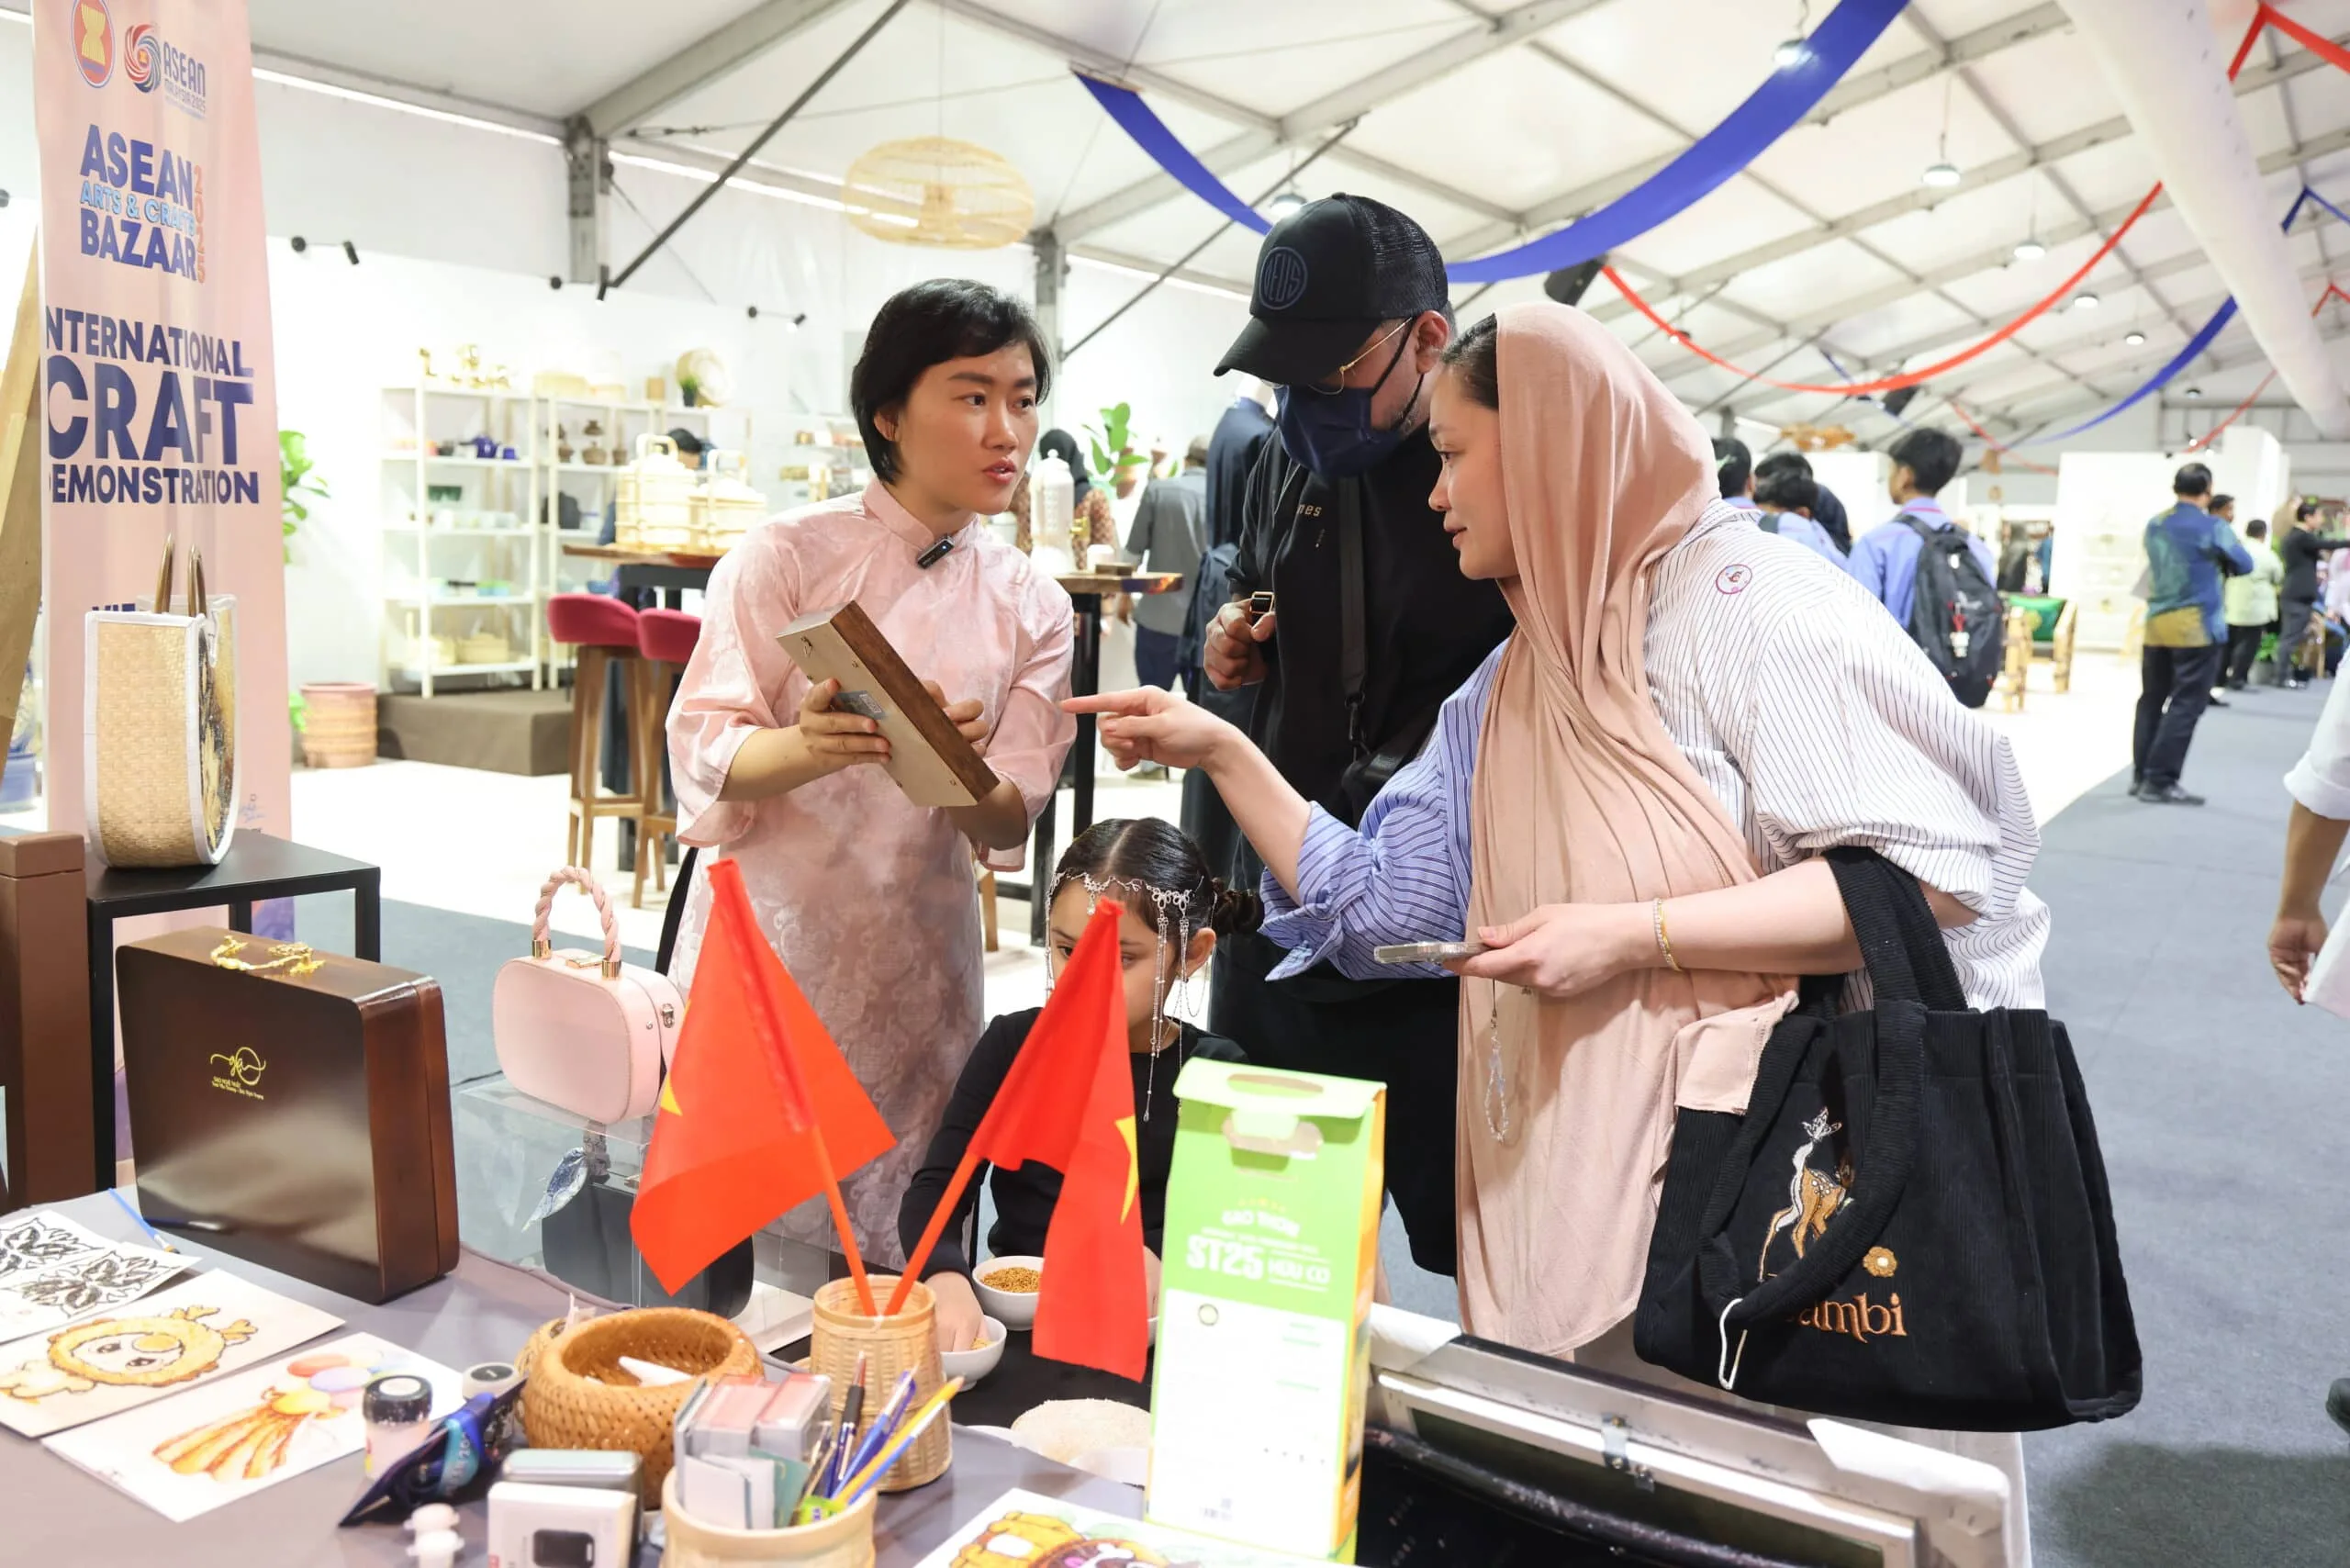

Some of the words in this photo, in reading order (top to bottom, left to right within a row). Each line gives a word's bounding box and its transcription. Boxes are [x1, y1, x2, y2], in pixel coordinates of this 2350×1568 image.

[162, 41, 206, 97] ASEAN
[80, 124, 193, 211] ASEAN
[80, 180, 121, 215] ARTS
[127, 194, 140, 219] &
[144, 198, 196, 237] CRAFTS
[194, 164, 206, 284] 2025
[80, 207, 197, 281] BAZAAR
[46, 306, 254, 377] NTERNATIONAL
[47, 354, 254, 465] CRAFT
[50, 464, 259, 504] EMONSTRATION
[1186, 1234, 1264, 1281] ST25
[1797, 1292, 1908, 1343] ambi
